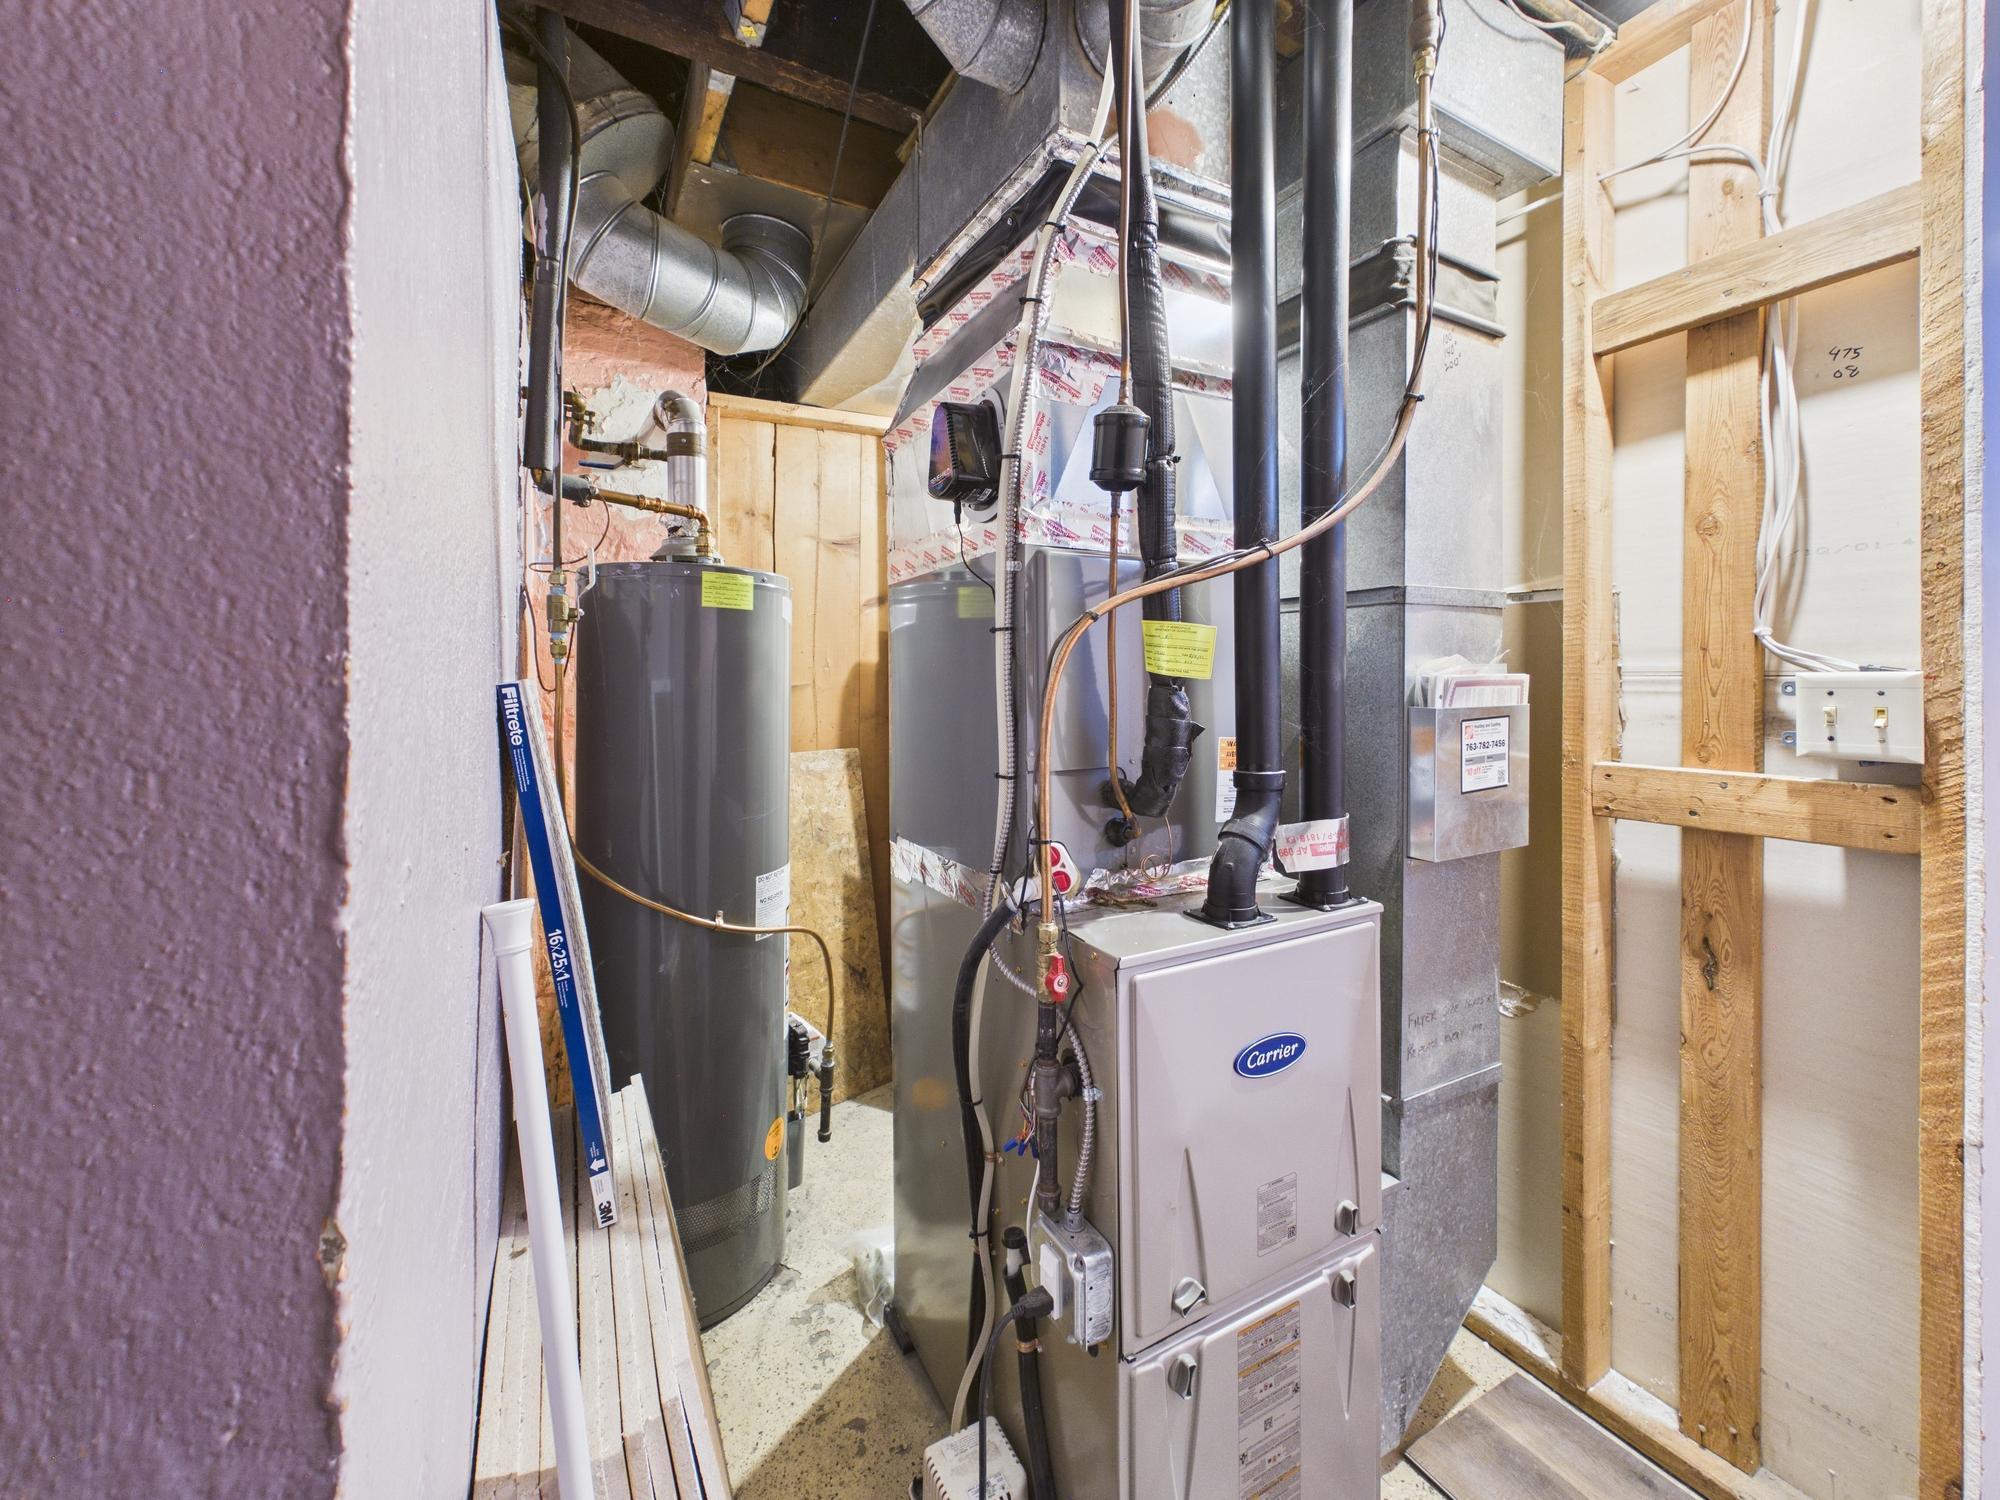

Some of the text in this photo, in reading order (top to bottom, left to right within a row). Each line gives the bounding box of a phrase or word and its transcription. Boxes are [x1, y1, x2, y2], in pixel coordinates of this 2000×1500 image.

[1829, 346, 1864, 361] 475
[501, 686, 524, 746] Filtrete
[548, 928, 571, 981] 16x25x1
[1246, 1042, 1299, 1069] Carrier
[599, 1200, 614, 1225] 3M
